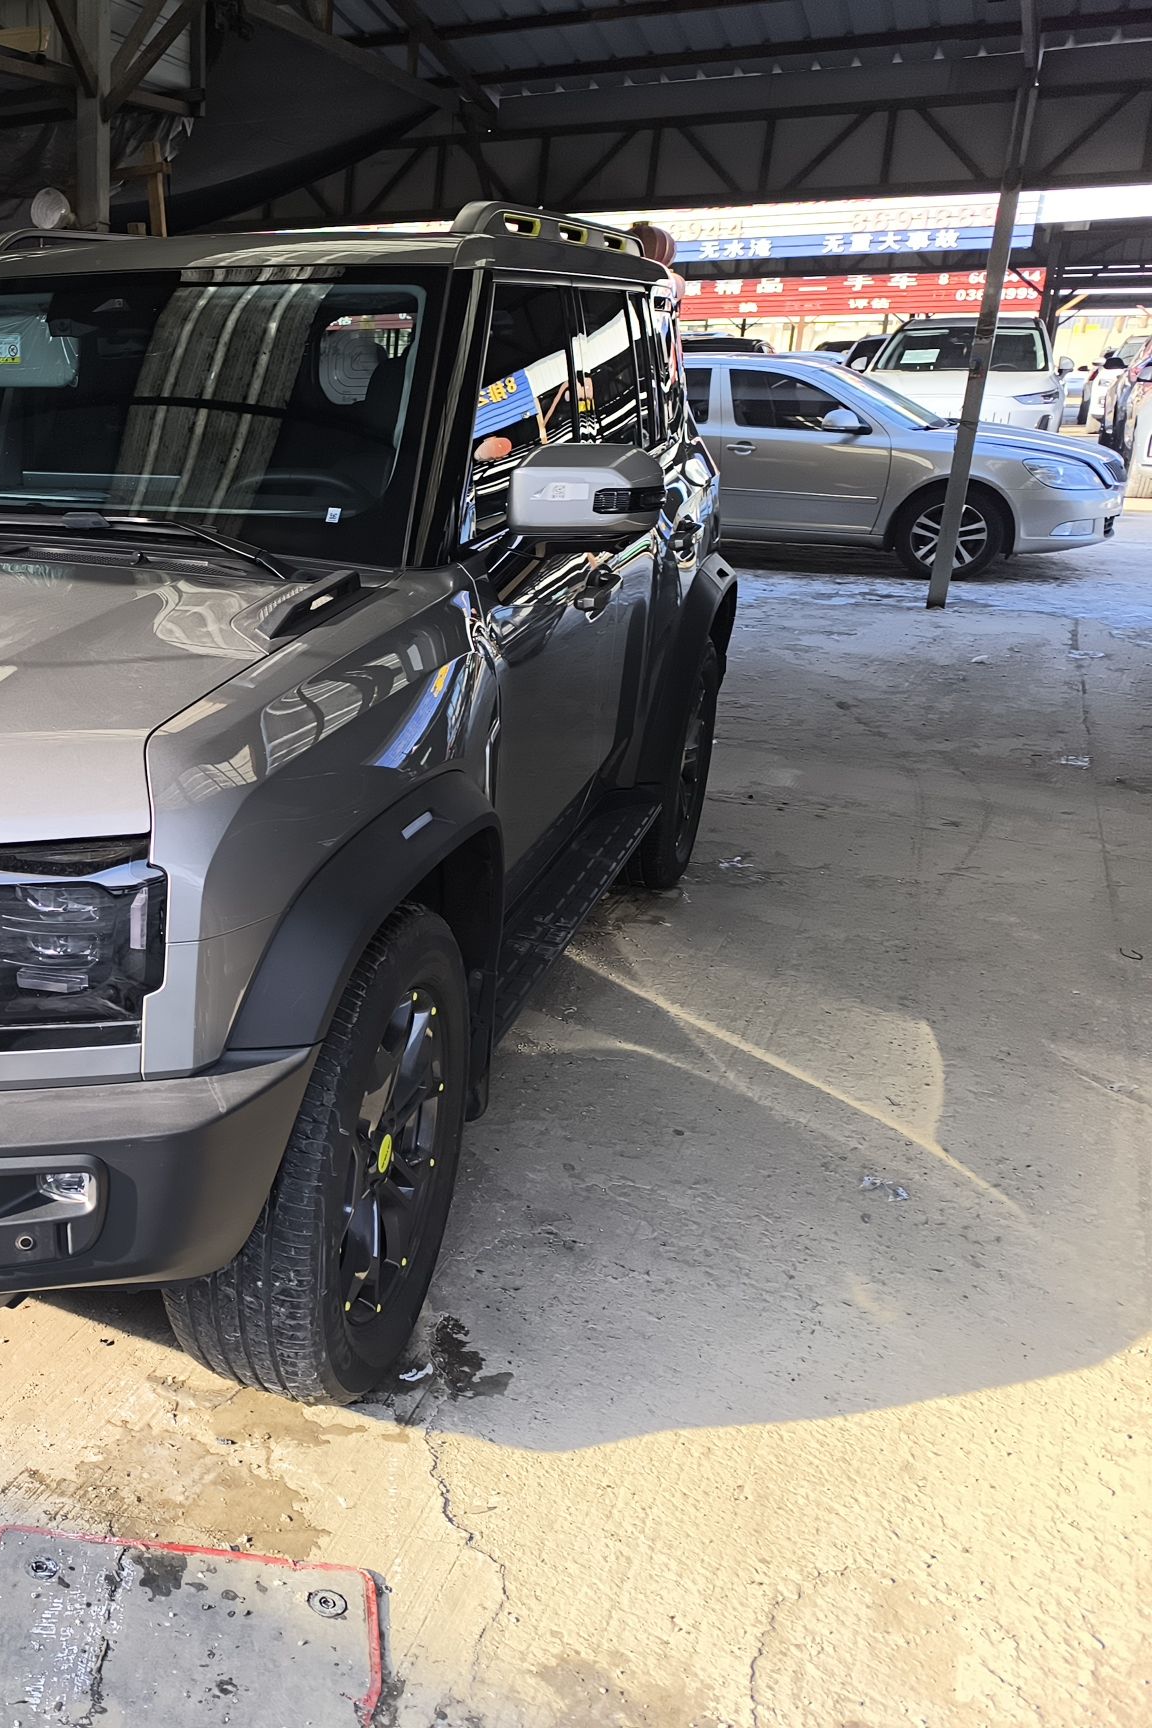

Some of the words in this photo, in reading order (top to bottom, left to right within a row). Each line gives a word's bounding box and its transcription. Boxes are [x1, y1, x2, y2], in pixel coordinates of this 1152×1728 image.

[822, 229, 960, 253] 无重大事故
